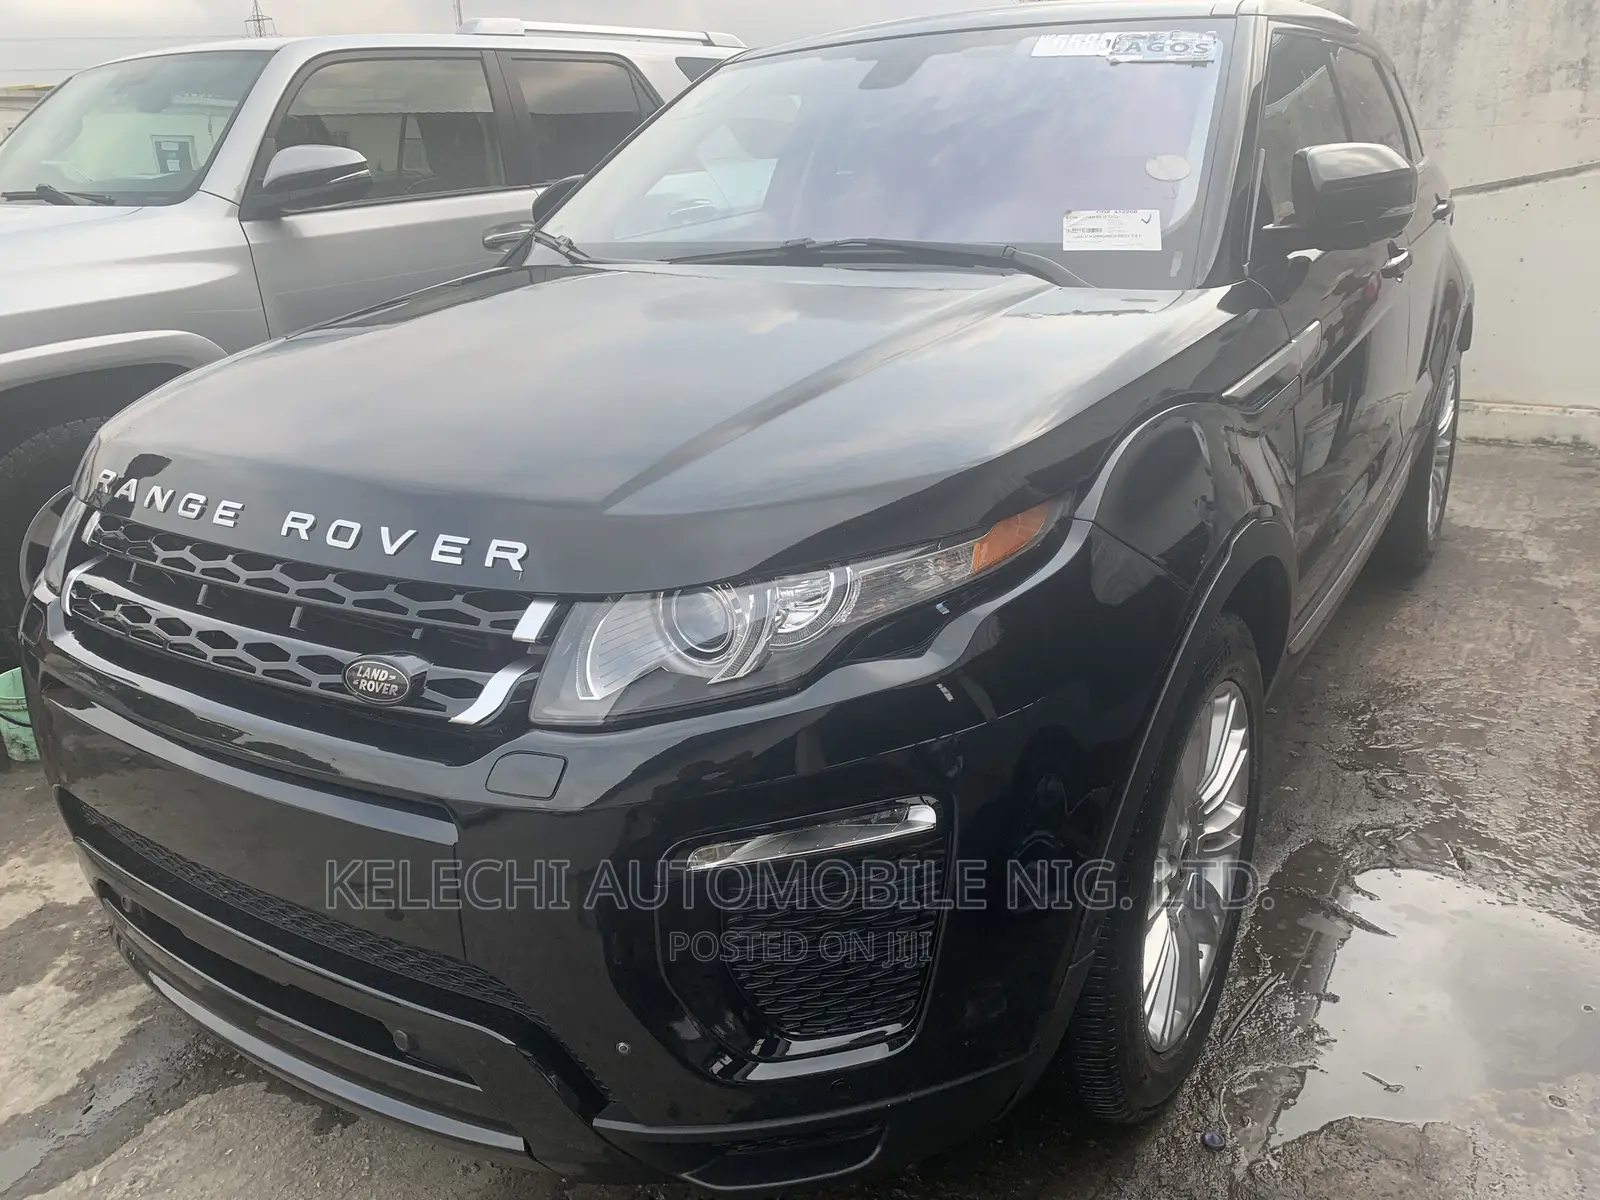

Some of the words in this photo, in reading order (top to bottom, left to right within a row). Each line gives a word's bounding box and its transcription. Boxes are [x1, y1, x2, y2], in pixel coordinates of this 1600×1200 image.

[96, 468, 244, 528] RANGE
[280, 510, 528, 572] ROVER
[356, 665, 389, 682] LAND
[358, 678, 399, 696] ROVER
